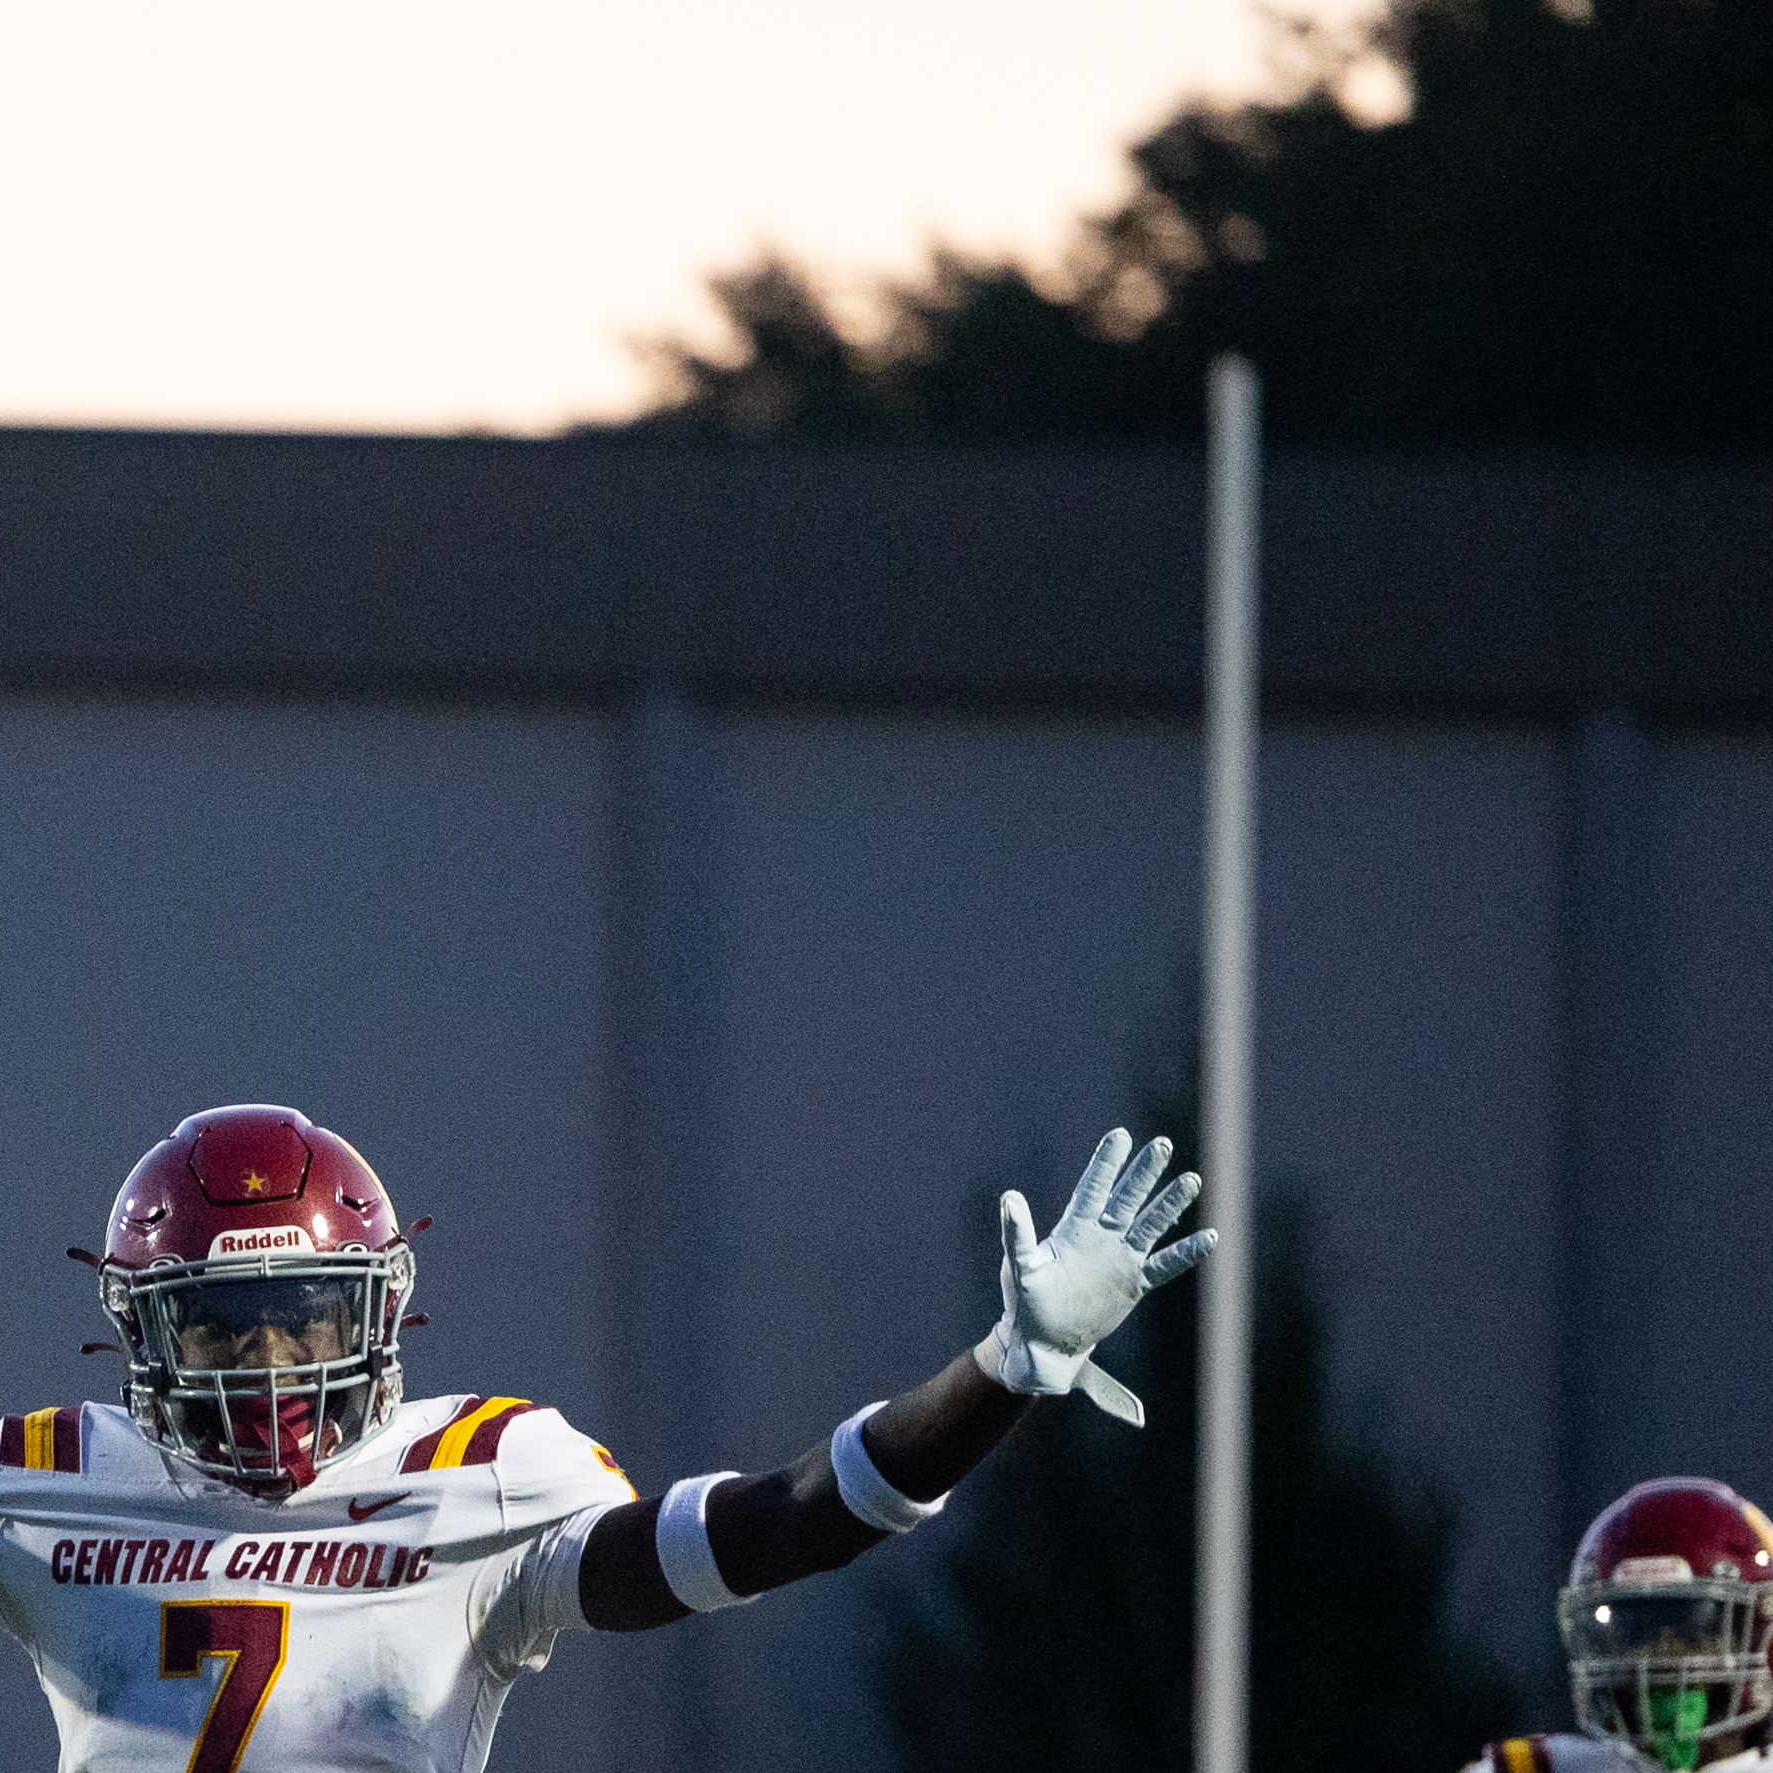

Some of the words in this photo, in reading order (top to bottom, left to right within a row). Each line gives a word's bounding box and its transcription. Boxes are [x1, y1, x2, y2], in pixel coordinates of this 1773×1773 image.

[220, 1231, 300, 1252] Riddell
[52, 1538, 218, 1585] CENTRAL
[225, 1540, 435, 1588] CATHOLIC
